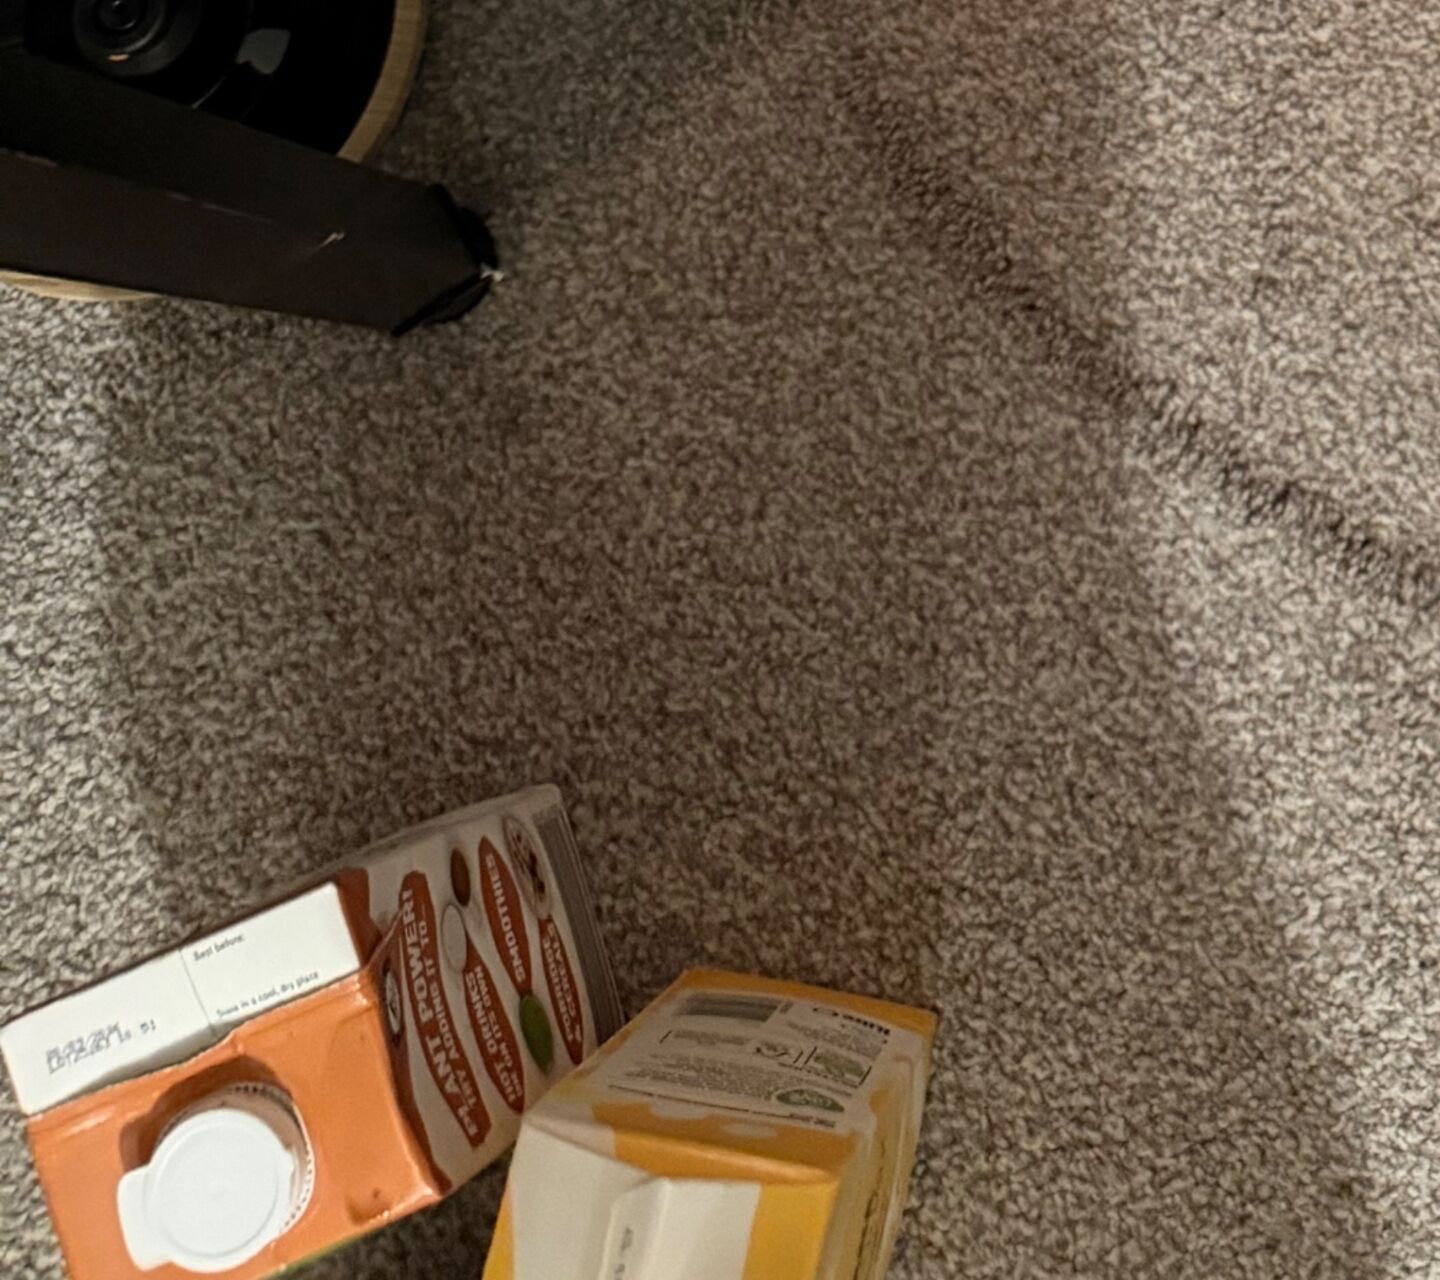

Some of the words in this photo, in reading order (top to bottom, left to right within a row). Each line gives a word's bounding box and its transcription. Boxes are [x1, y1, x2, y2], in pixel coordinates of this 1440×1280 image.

[401, 888, 435, 1022] POWER!
[481, 852, 527, 982] SMOOTHIES
[422, 955, 436, 976] IT
[544, 921, 578, 1018] CEREALS
[427, 980, 460, 1061] ADDING
[463, 970, 499, 1053] DRINKS
[423, 1031, 479, 1135] PLANT
[455, 1066, 478, 1108] TRY
[493, 1060, 518, 1101] HOT
